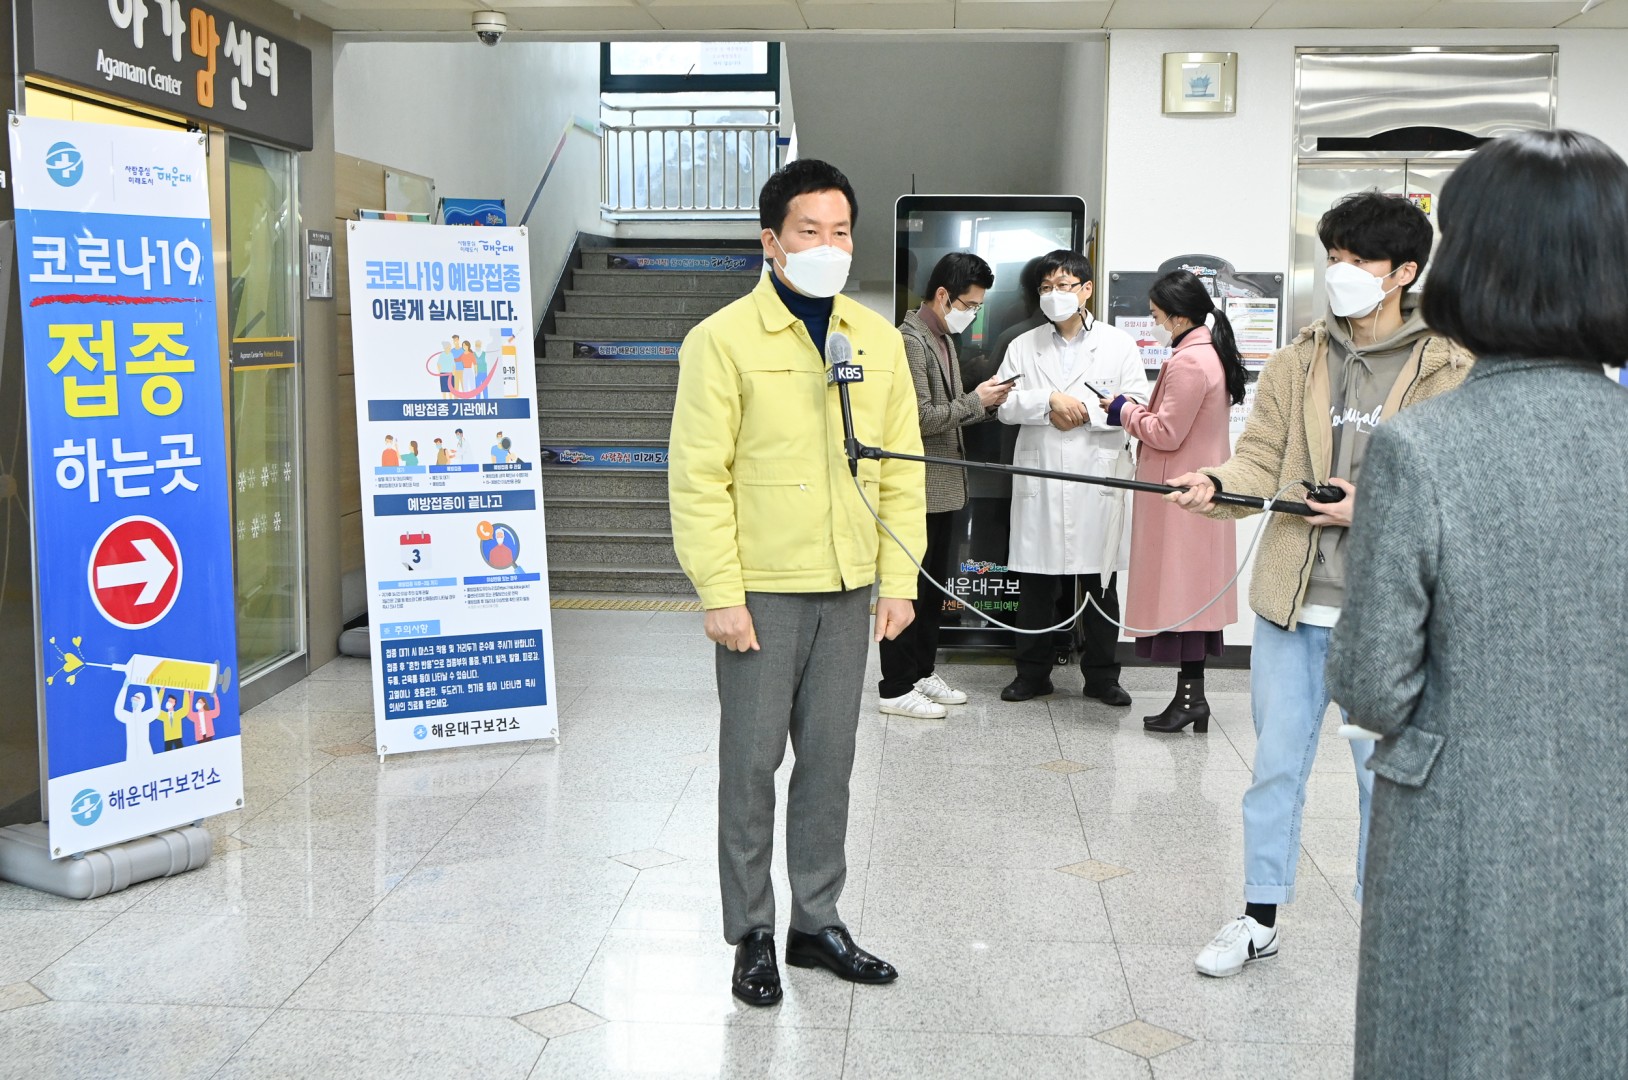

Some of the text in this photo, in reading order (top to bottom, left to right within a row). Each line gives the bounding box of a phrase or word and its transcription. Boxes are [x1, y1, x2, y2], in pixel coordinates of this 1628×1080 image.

[97, 48, 183, 97] Agamam Center
[152, 166, 192, 188] 해운대
[29, 236, 202, 290] 코로나19
[365, 261, 444, 292] 코로나19
[448, 262, 521, 293] 예방접종
[372, 298, 518, 321] 이렇게 실시됩니다.
[47, 320, 195, 418] 접종
[837, 367, 862, 380] KBS
[402, 402, 498, 417] 예방접종 기관에서
[407, 494, 503, 512] 예방접종이 끝나고
[412, 549, 421, 563] 3
[394, 623, 429, 635] 주의사항
[431, 717, 521, 738] 해운대구보건소
[108, 766, 222, 811] 해운대구보건소
